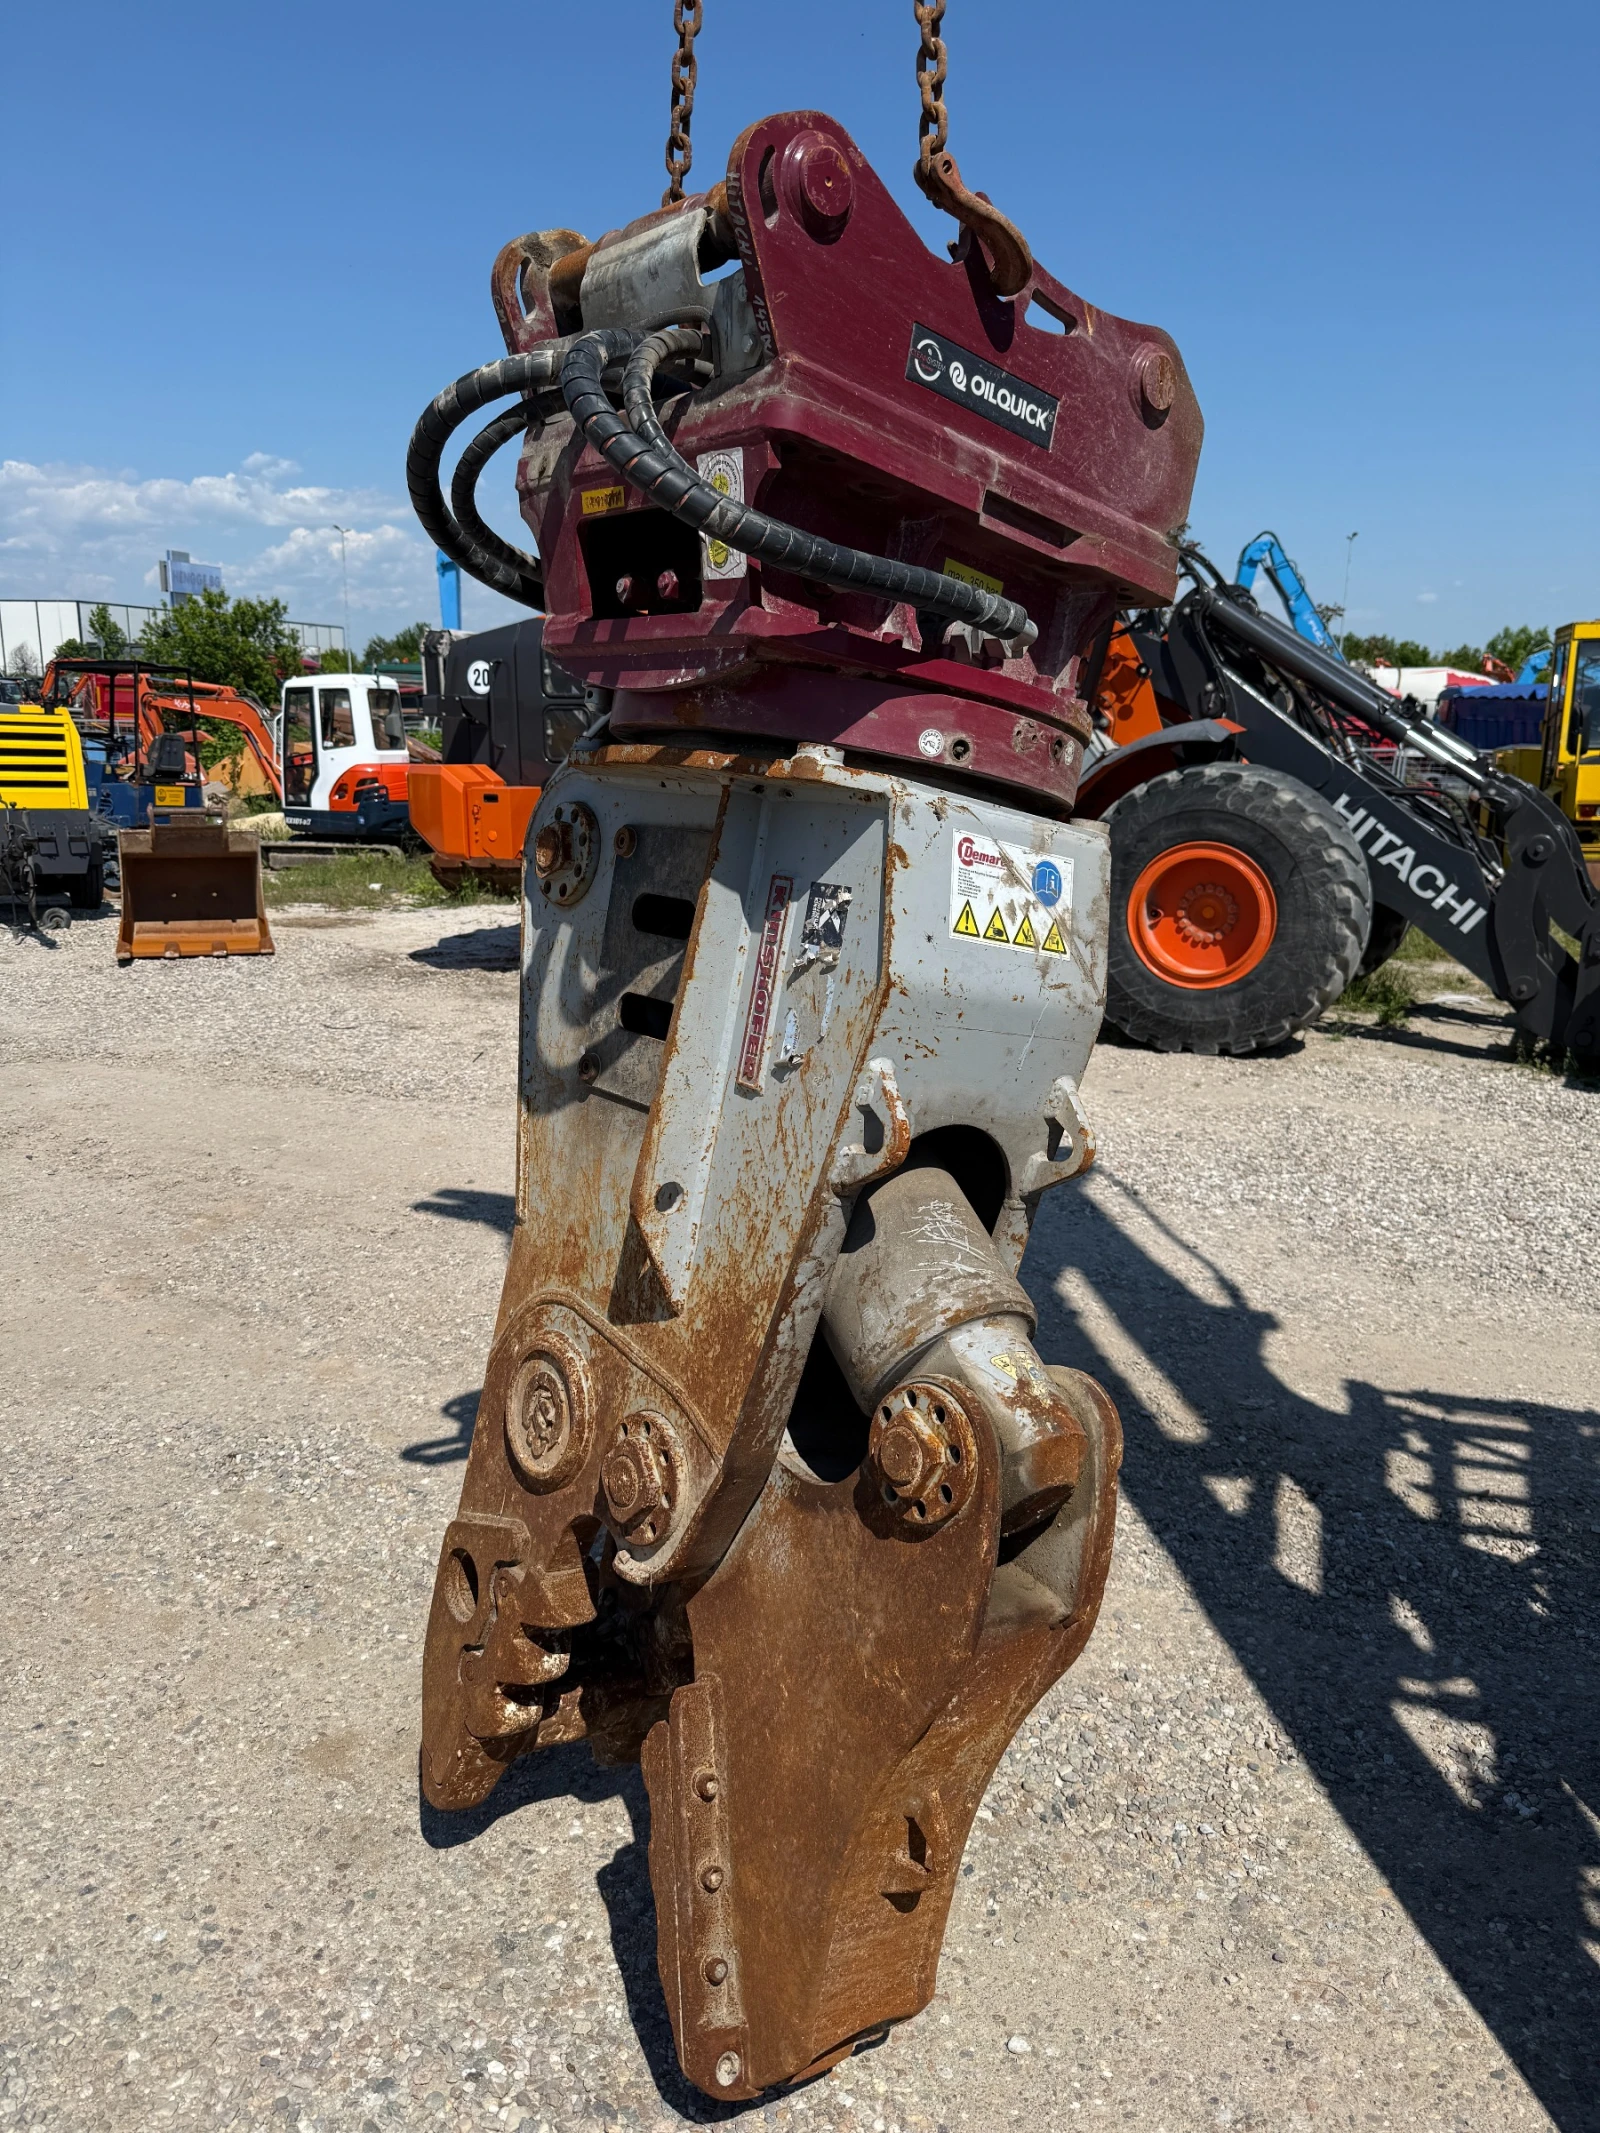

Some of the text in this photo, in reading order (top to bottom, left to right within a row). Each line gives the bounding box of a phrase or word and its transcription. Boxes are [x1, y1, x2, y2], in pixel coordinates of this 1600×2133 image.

[970, 375, 1047, 432] OILQUICK
[473, 667, 490, 687] 20
[964, 843, 1010, 867] Demar
[1332, 792, 1488, 935] HITACHI
[743, 885, 787, 1080] KINSHOFER
